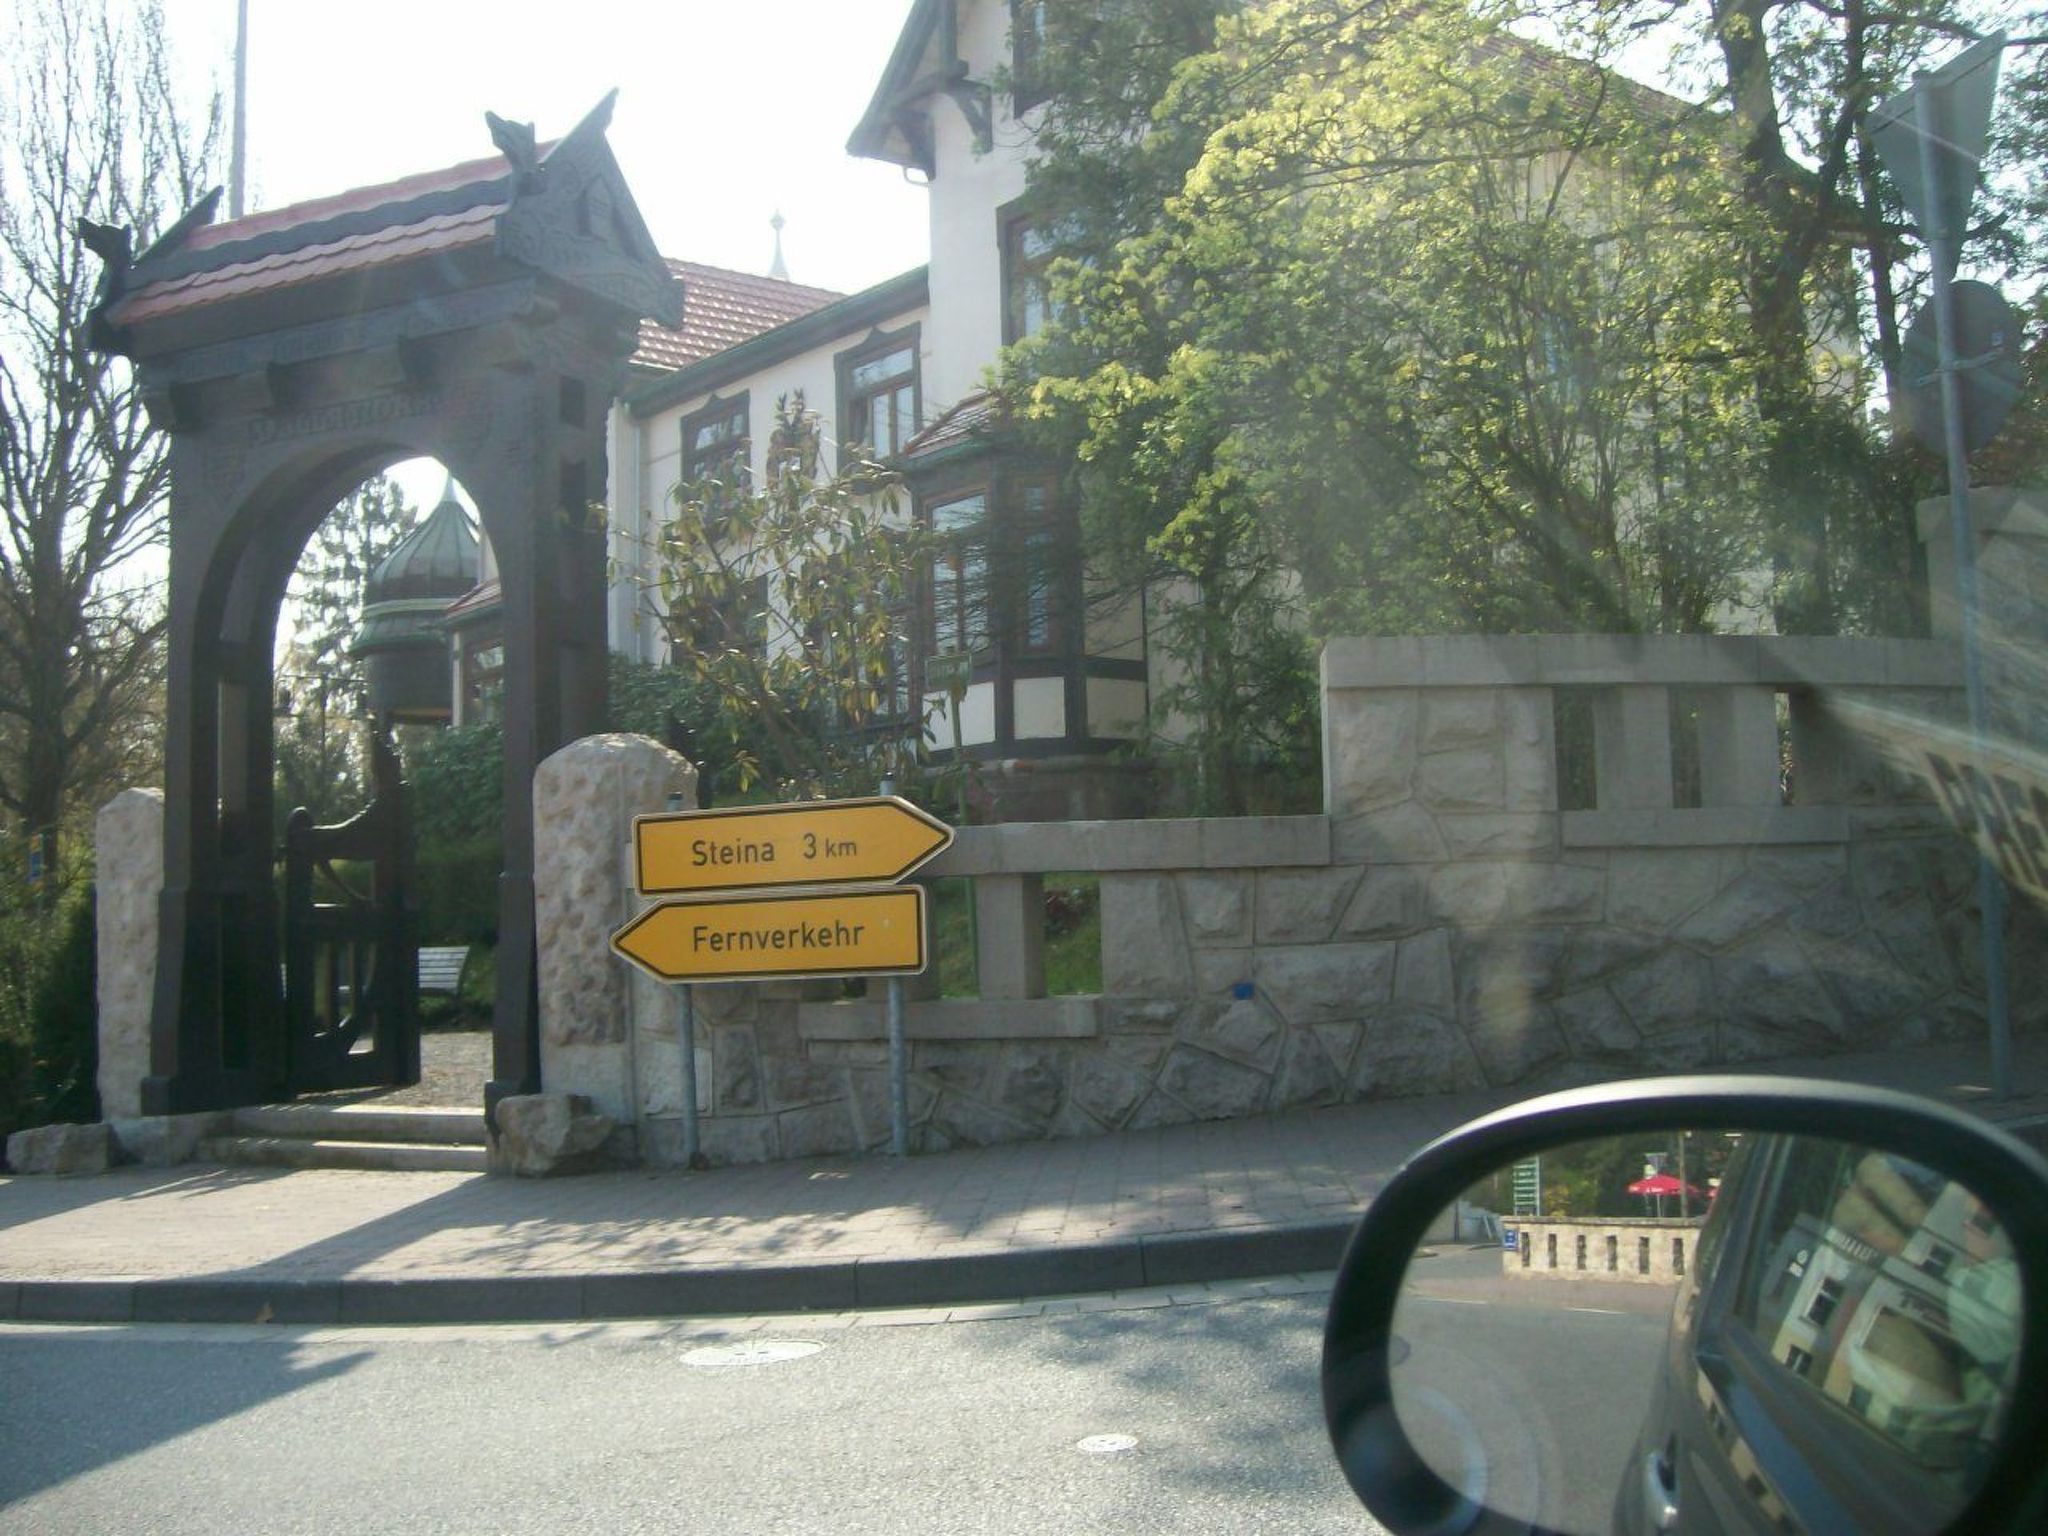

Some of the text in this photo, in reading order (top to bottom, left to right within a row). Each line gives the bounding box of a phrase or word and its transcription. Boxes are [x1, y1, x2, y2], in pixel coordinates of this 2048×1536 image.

[692, 833, 857, 866] Steina 3 km
[693, 919, 865, 952] Fernverkehr
